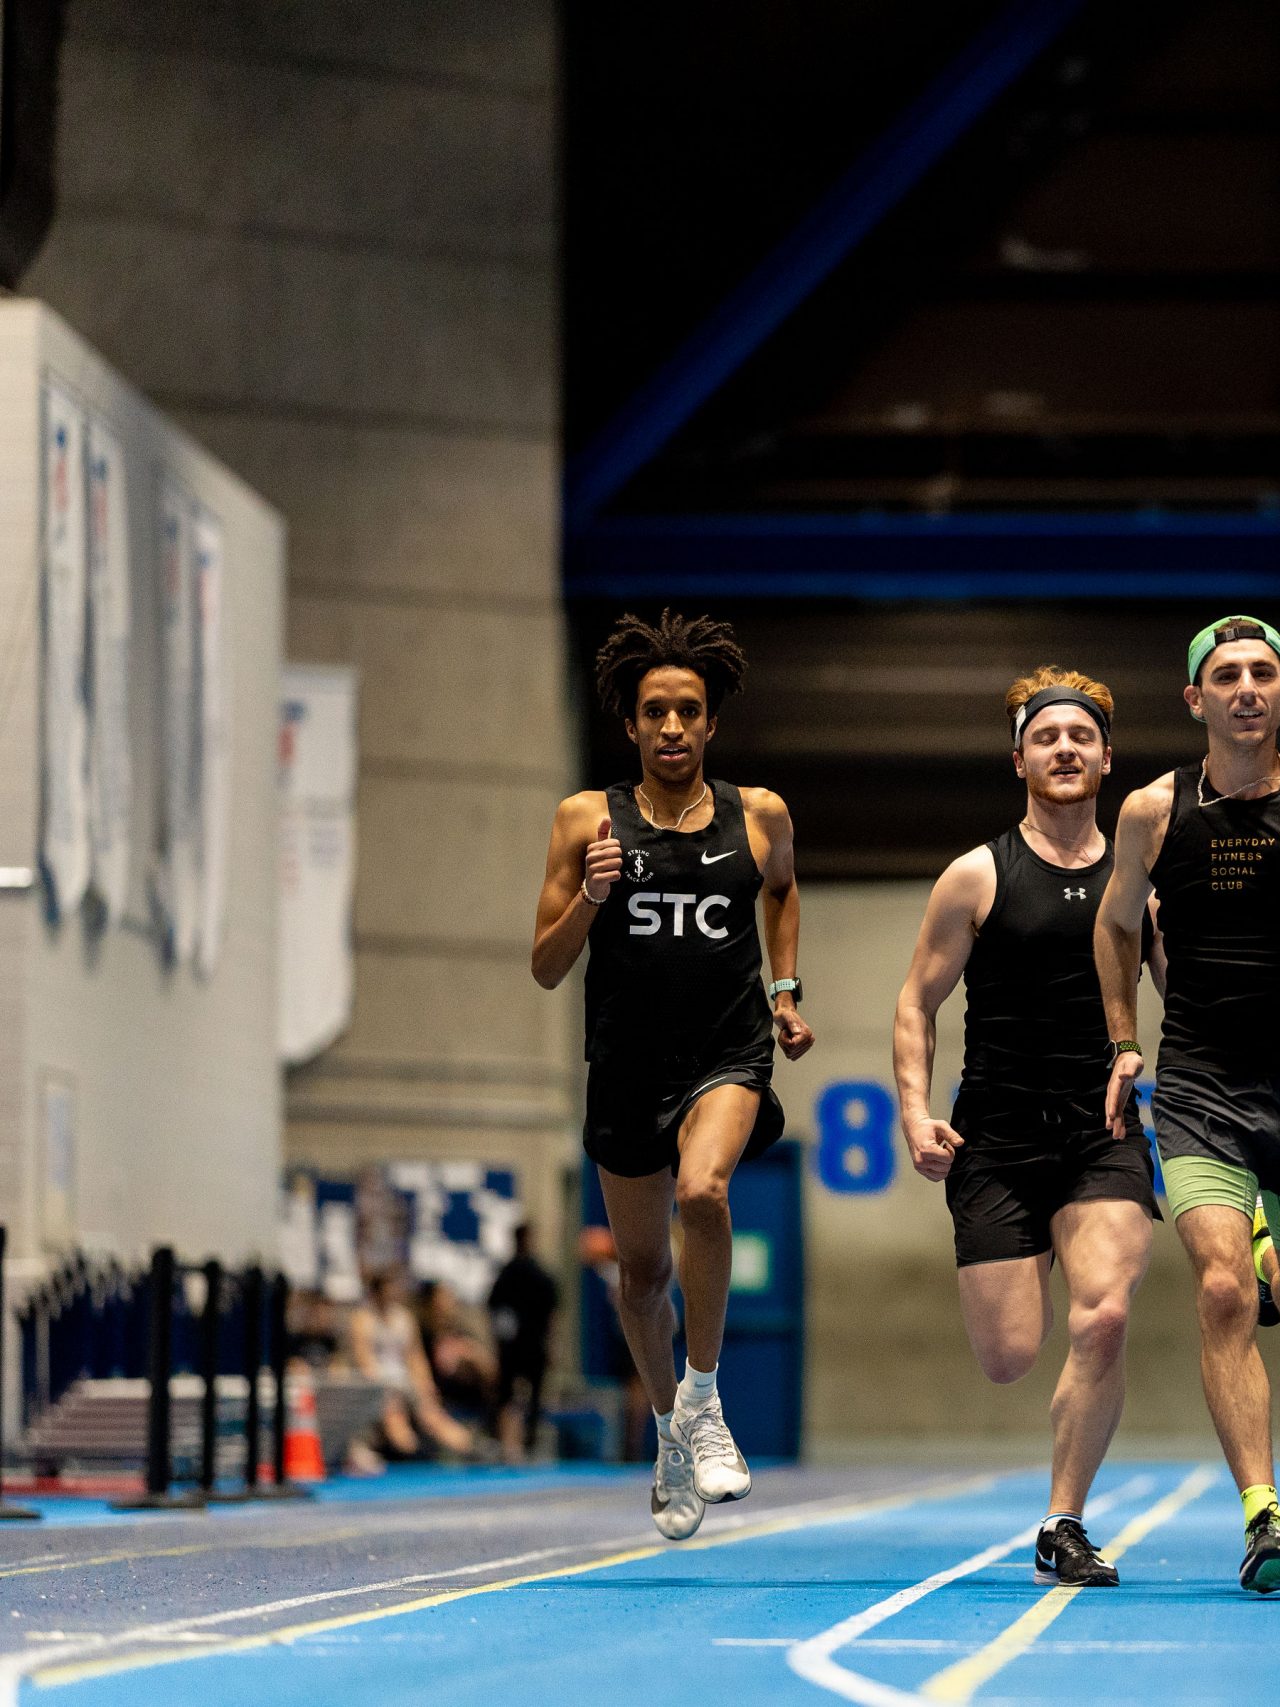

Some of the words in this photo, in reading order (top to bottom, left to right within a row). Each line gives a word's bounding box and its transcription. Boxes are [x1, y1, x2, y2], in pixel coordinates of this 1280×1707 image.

[1211, 838, 1275, 848] EVERYDAY
[627, 849, 650, 857] STRING
[1211, 852, 1263, 861] FITNESS
[1211, 867, 1256, 876] SOCIAL
[1211, 881, 1243, 890] CLUB
[628, 892, 731, 939] STC
[815, 1082, 893, 1194] 8
